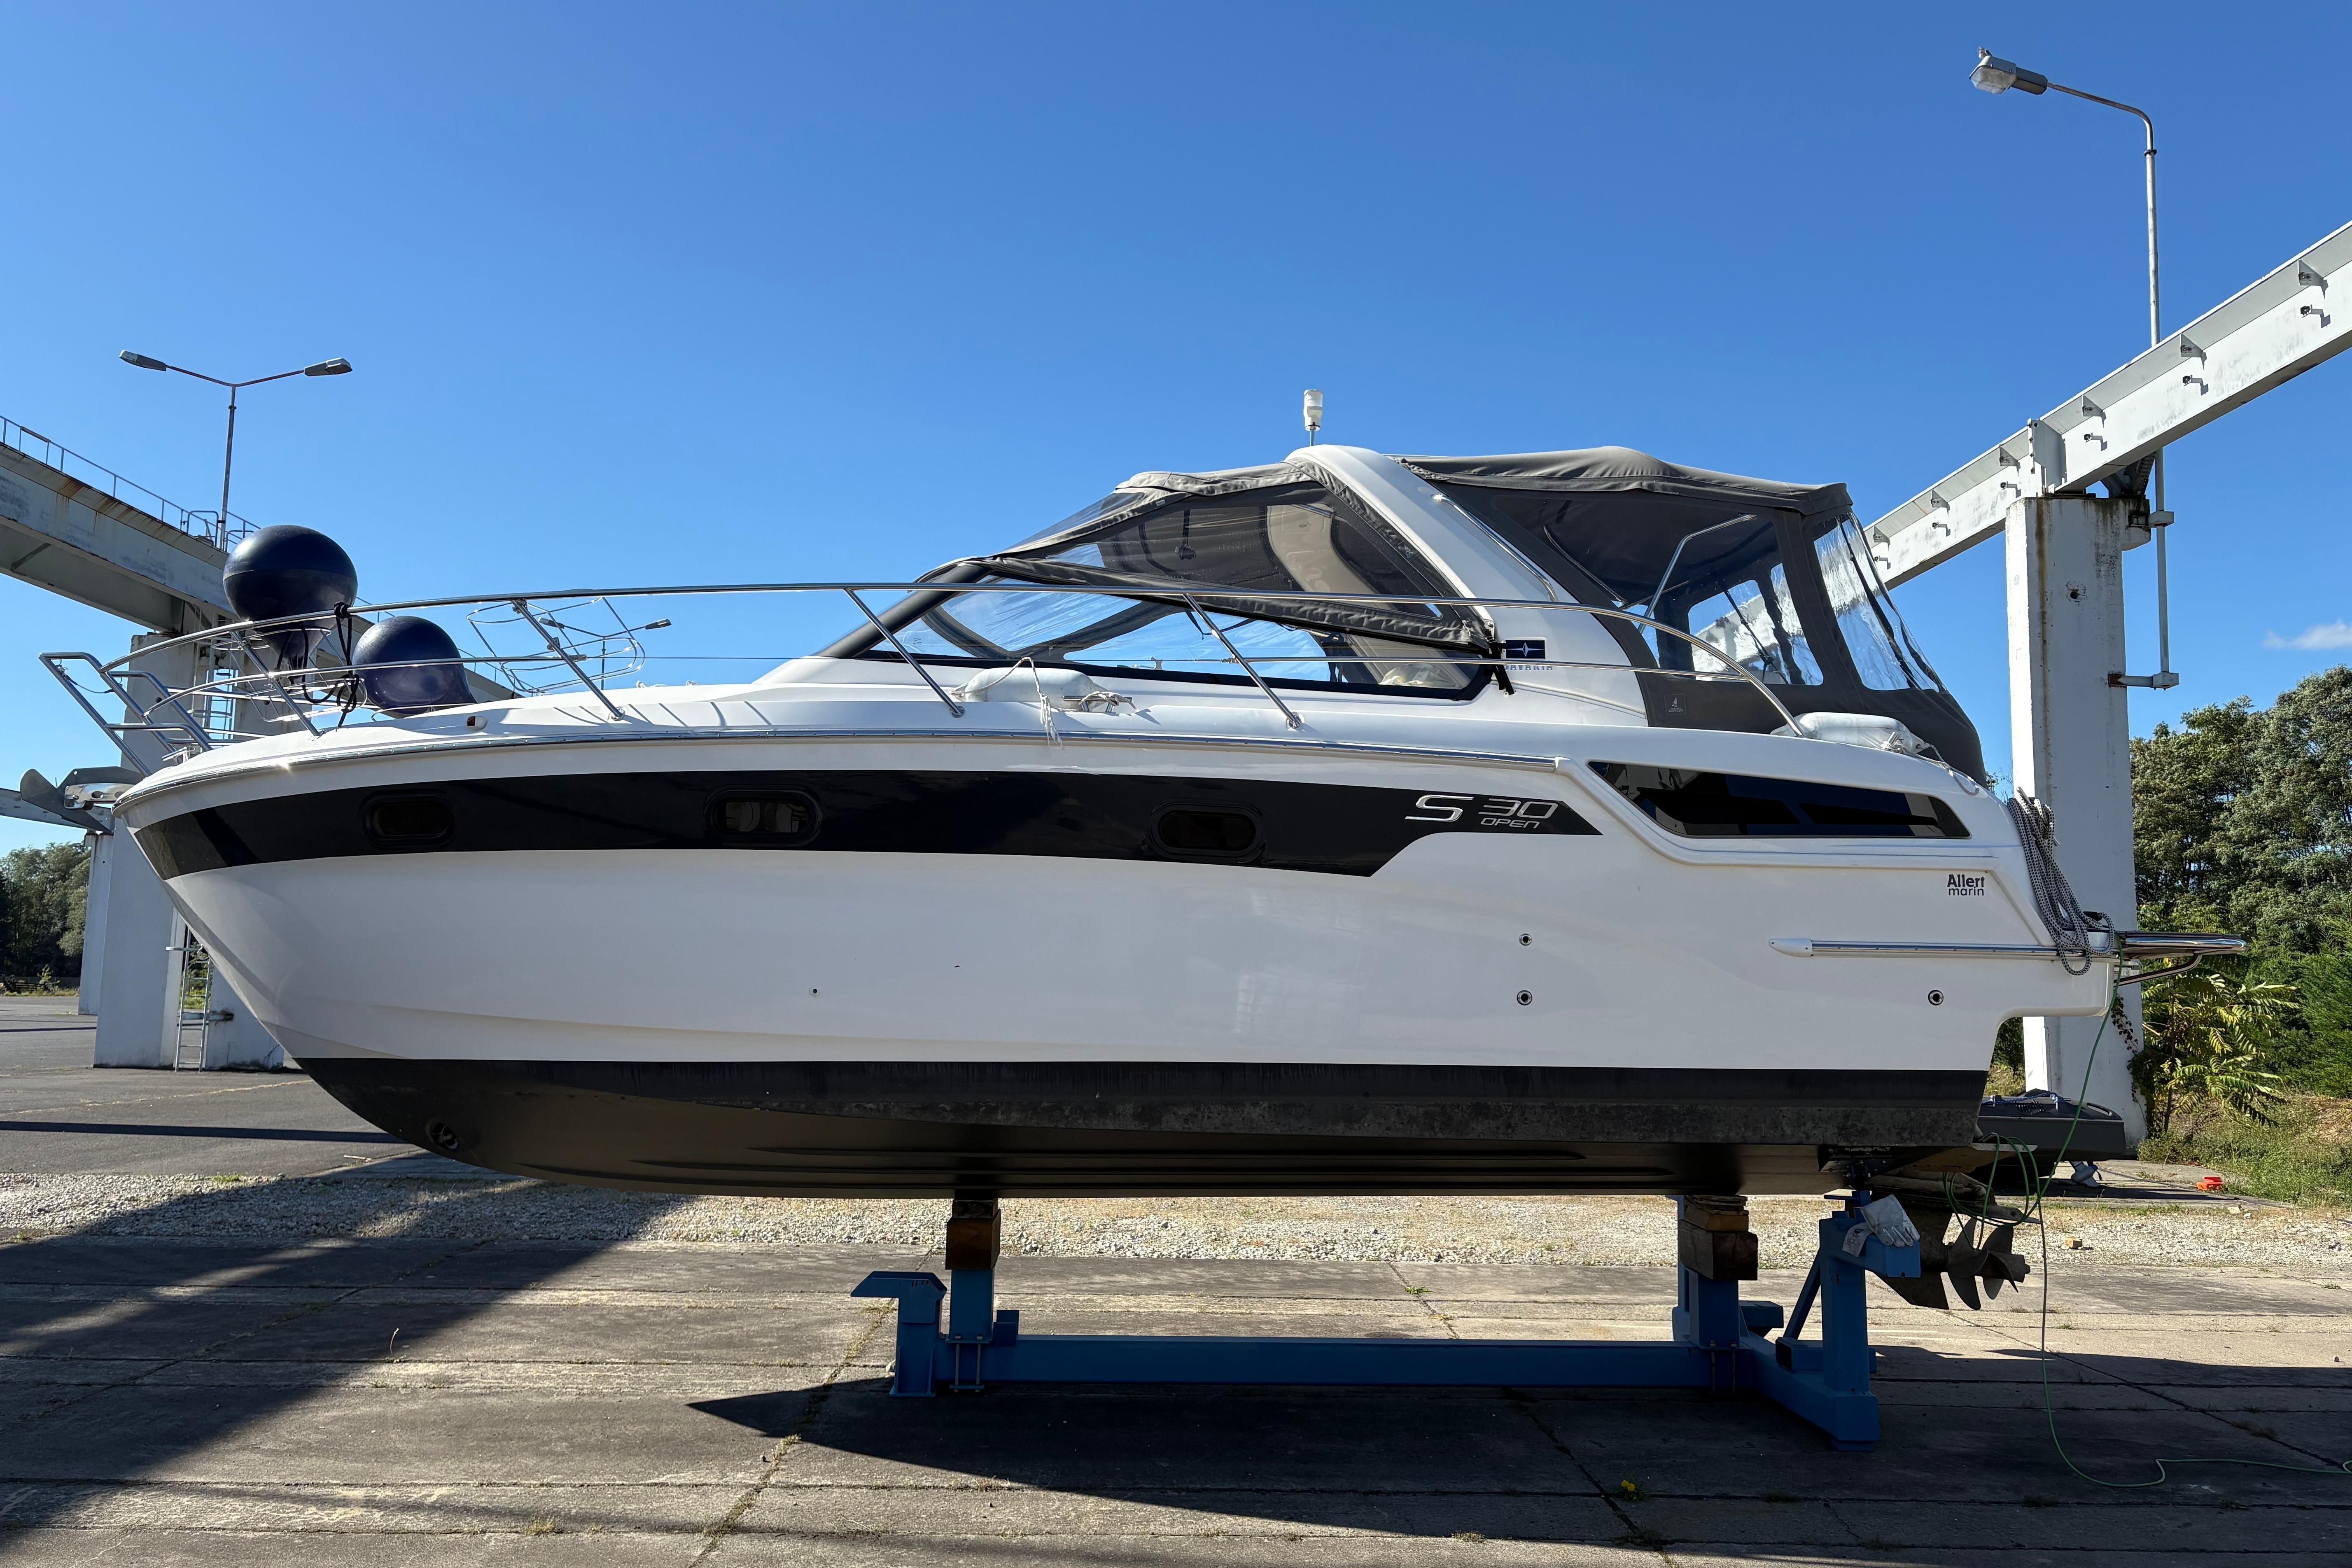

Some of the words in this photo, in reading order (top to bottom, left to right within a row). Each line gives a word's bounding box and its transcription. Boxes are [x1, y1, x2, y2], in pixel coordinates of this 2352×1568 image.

[1405, 794, 1474, 822] S
[1478, 798, 1558, 819] 30
[1480, 817, 1540, 829] OPEN
[1947, 874, 1985, 887] Allert
[1948, 887, 1984, 896] marin
